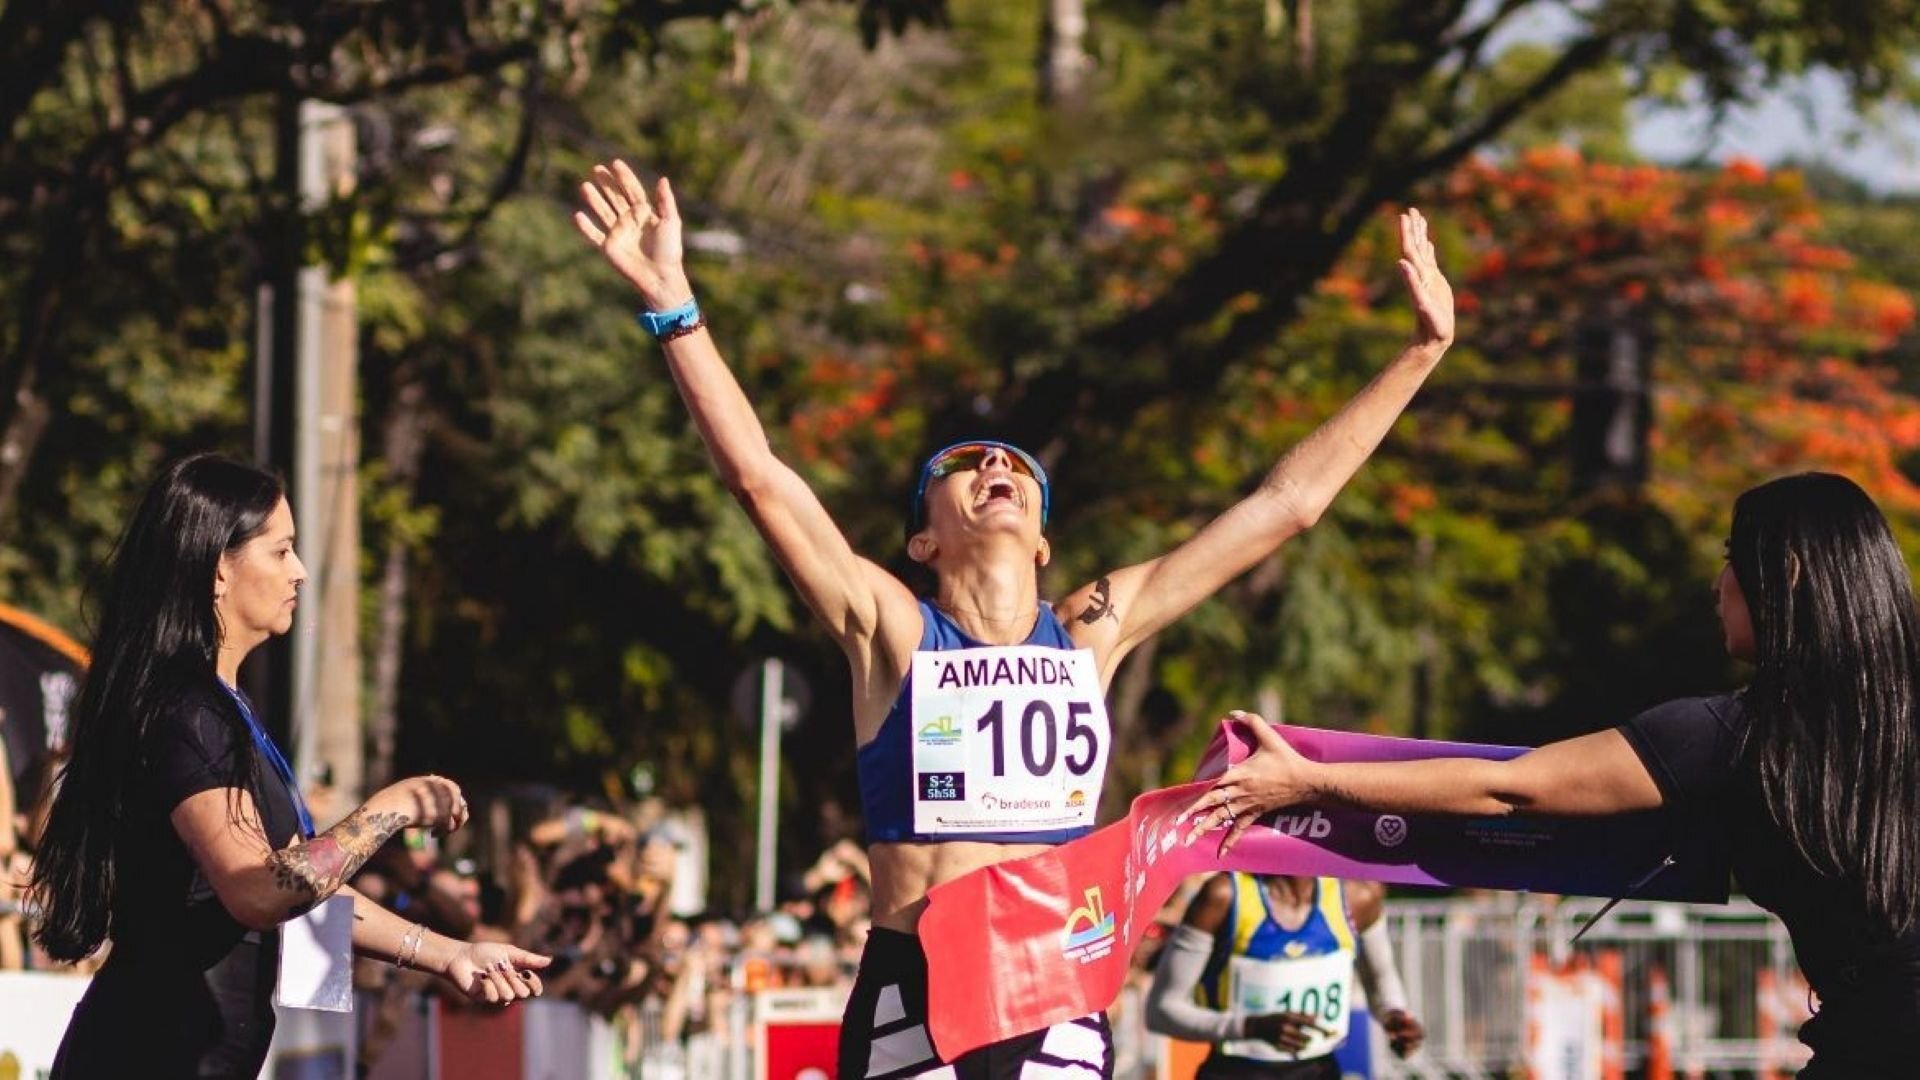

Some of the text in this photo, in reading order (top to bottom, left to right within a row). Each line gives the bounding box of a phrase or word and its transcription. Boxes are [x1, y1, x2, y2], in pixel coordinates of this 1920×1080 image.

[938, 657, 1074, 689] AMANDA
[977, 700, 1098, 777] 105
[927, 788, 957, 799] 5h58
[929, 775, 954, 788] S-2
[1000, 798, 1051, 810] bradesco
[1273, 810, 1332, 838] rvb
[1277, 983, 1342, 1021] 108
